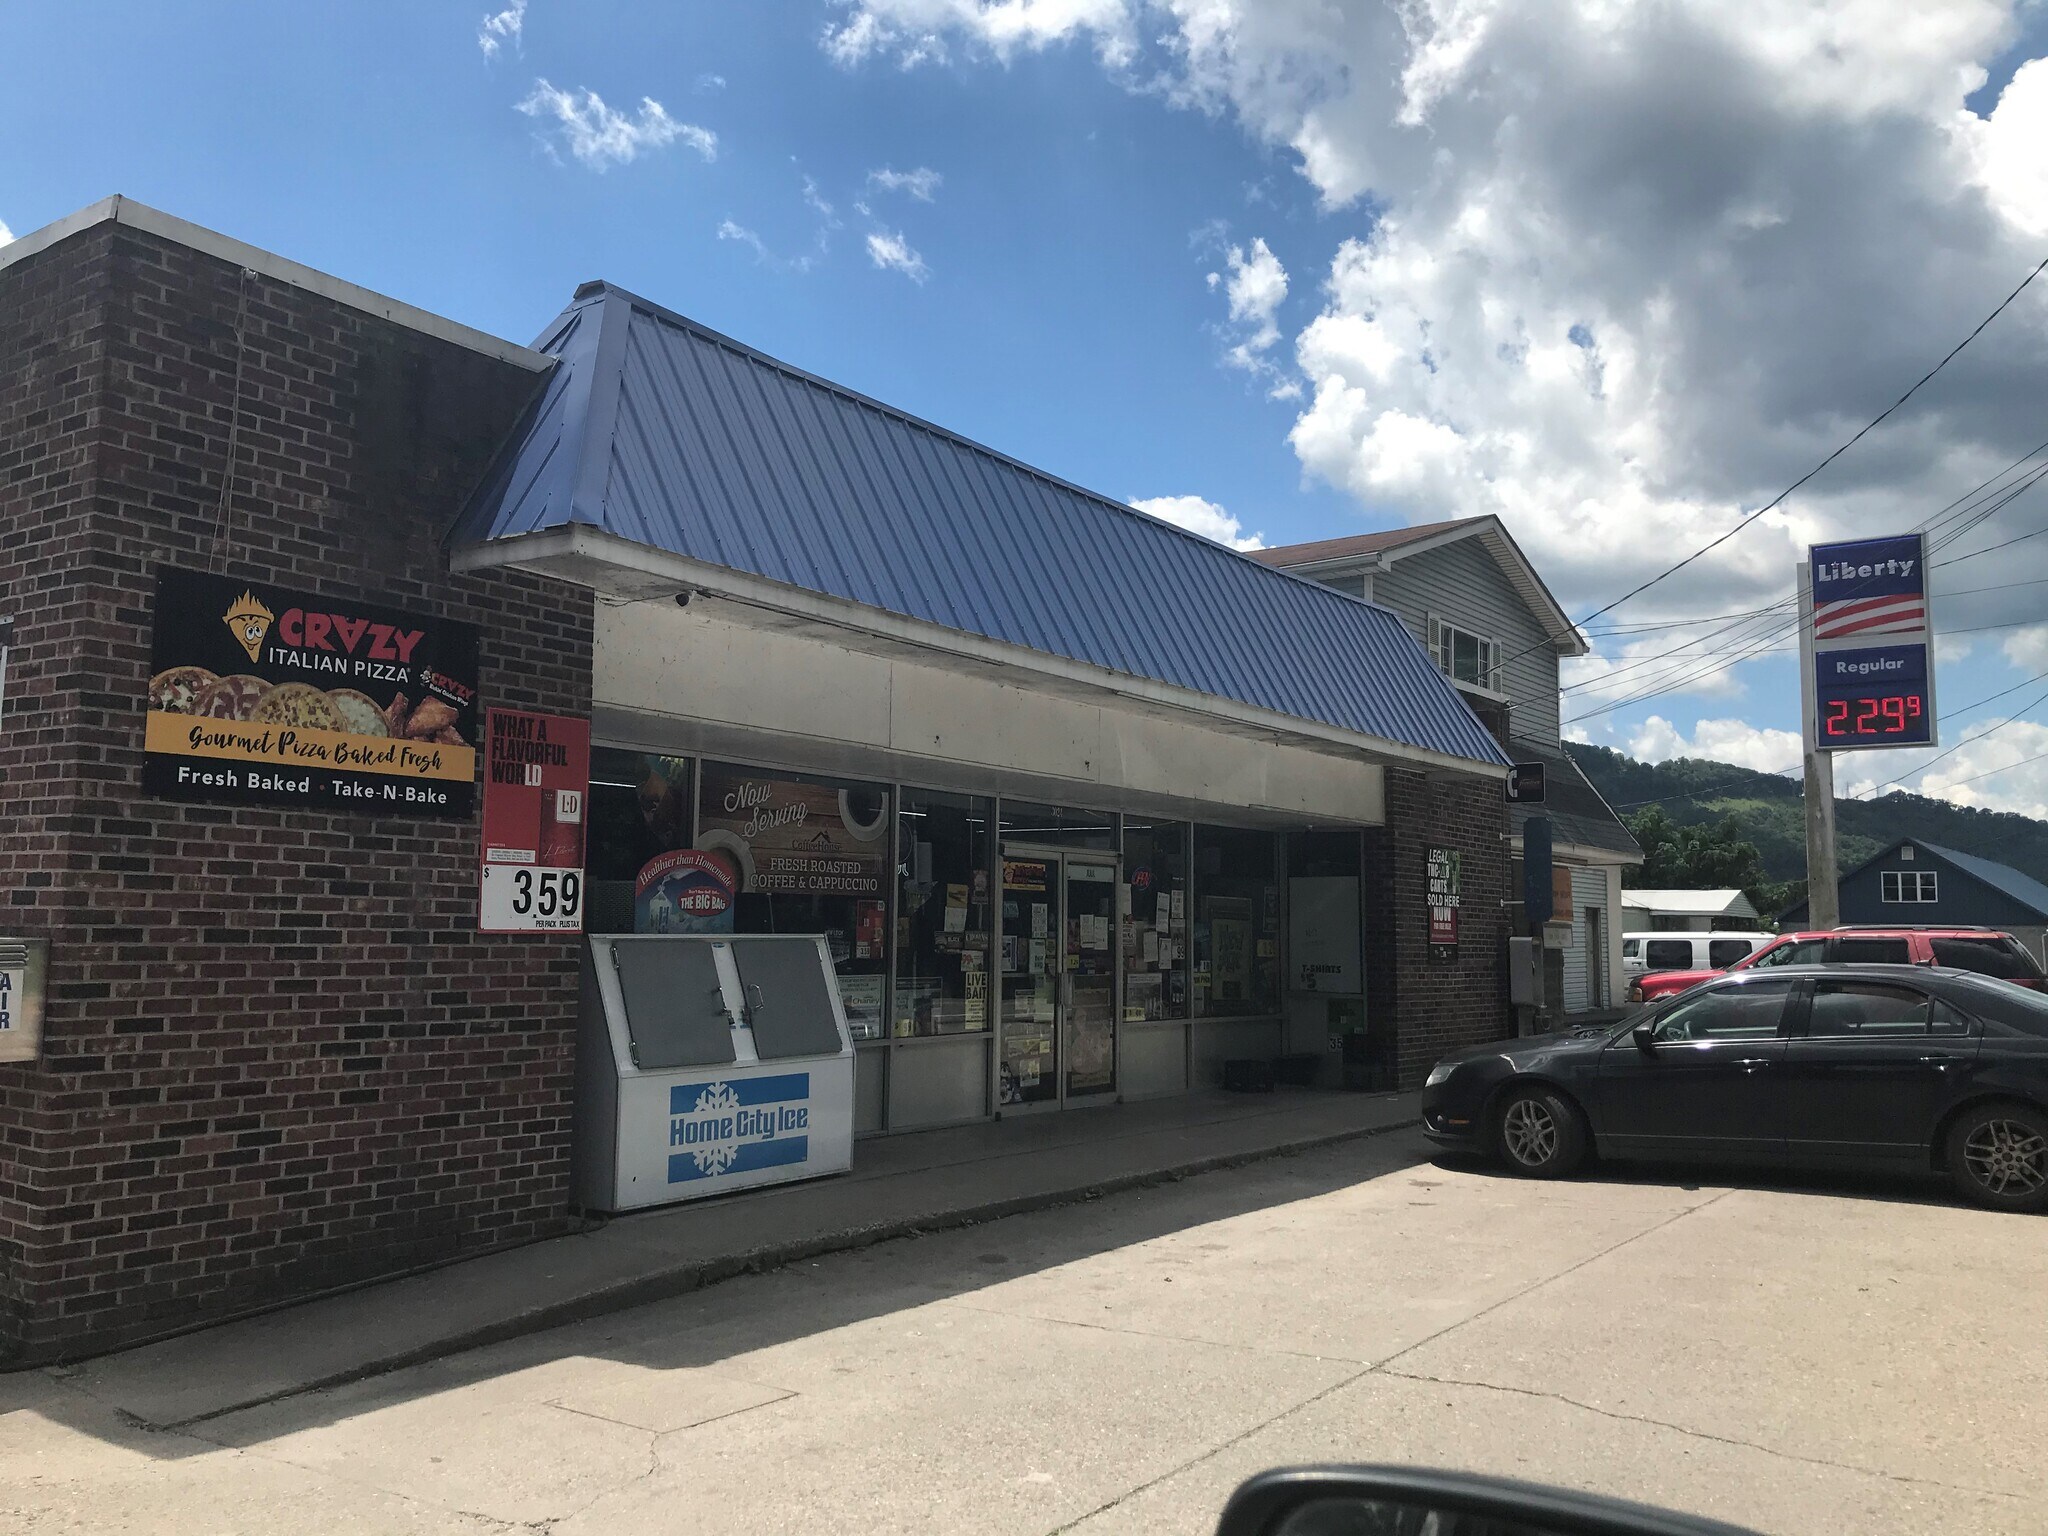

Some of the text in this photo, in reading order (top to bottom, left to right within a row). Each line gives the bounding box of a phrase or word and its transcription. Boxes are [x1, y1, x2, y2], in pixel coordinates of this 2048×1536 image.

[1819, 558, 1914, 582] Liberty
[279, 608, 425, 664] CRAZY
[269, 647, 409, 683] ITALIAN PIZZA
[1836, 658, 1904, 674] Regular
[493, 713, 547, 741] WHAT A
[189, 725, 442, 773] Gourmet Pizza Baked Fresh
[491, 737, 568, 766] FLAVORFUL
[491, 760, 542, 786] WORLD
[178, 767, 447, 804] Fresh Baked Take-N-Bake
[724, 781, 772, 812] Now
[741, 802, 809, 837] Serving
[770, 857, 861, 874] FRESH ROASTED
[1428, 849, 1449, 863] LEGAL
[484, 867, 489, 878] $
[639, 853, 732, 887] Healthier than Homemade
[750, 873, 878, 891] COFFEE & CAPPUCCINO
[1430, 878, 1447, 893] CARTS
[681, 894, 726, 909] THE BIG BAG
[1427, 893, 1460, 907] SOLD HERE
[536, 920, 580, 928] PER PACK PLUS TAX
[1433, 906, 1451, 921] NOW
[967, 973, 986, 986] LIVE
[966, 986, 986, 1000] BAIT
[669, 1106, 808, 1146] Home City Ice
